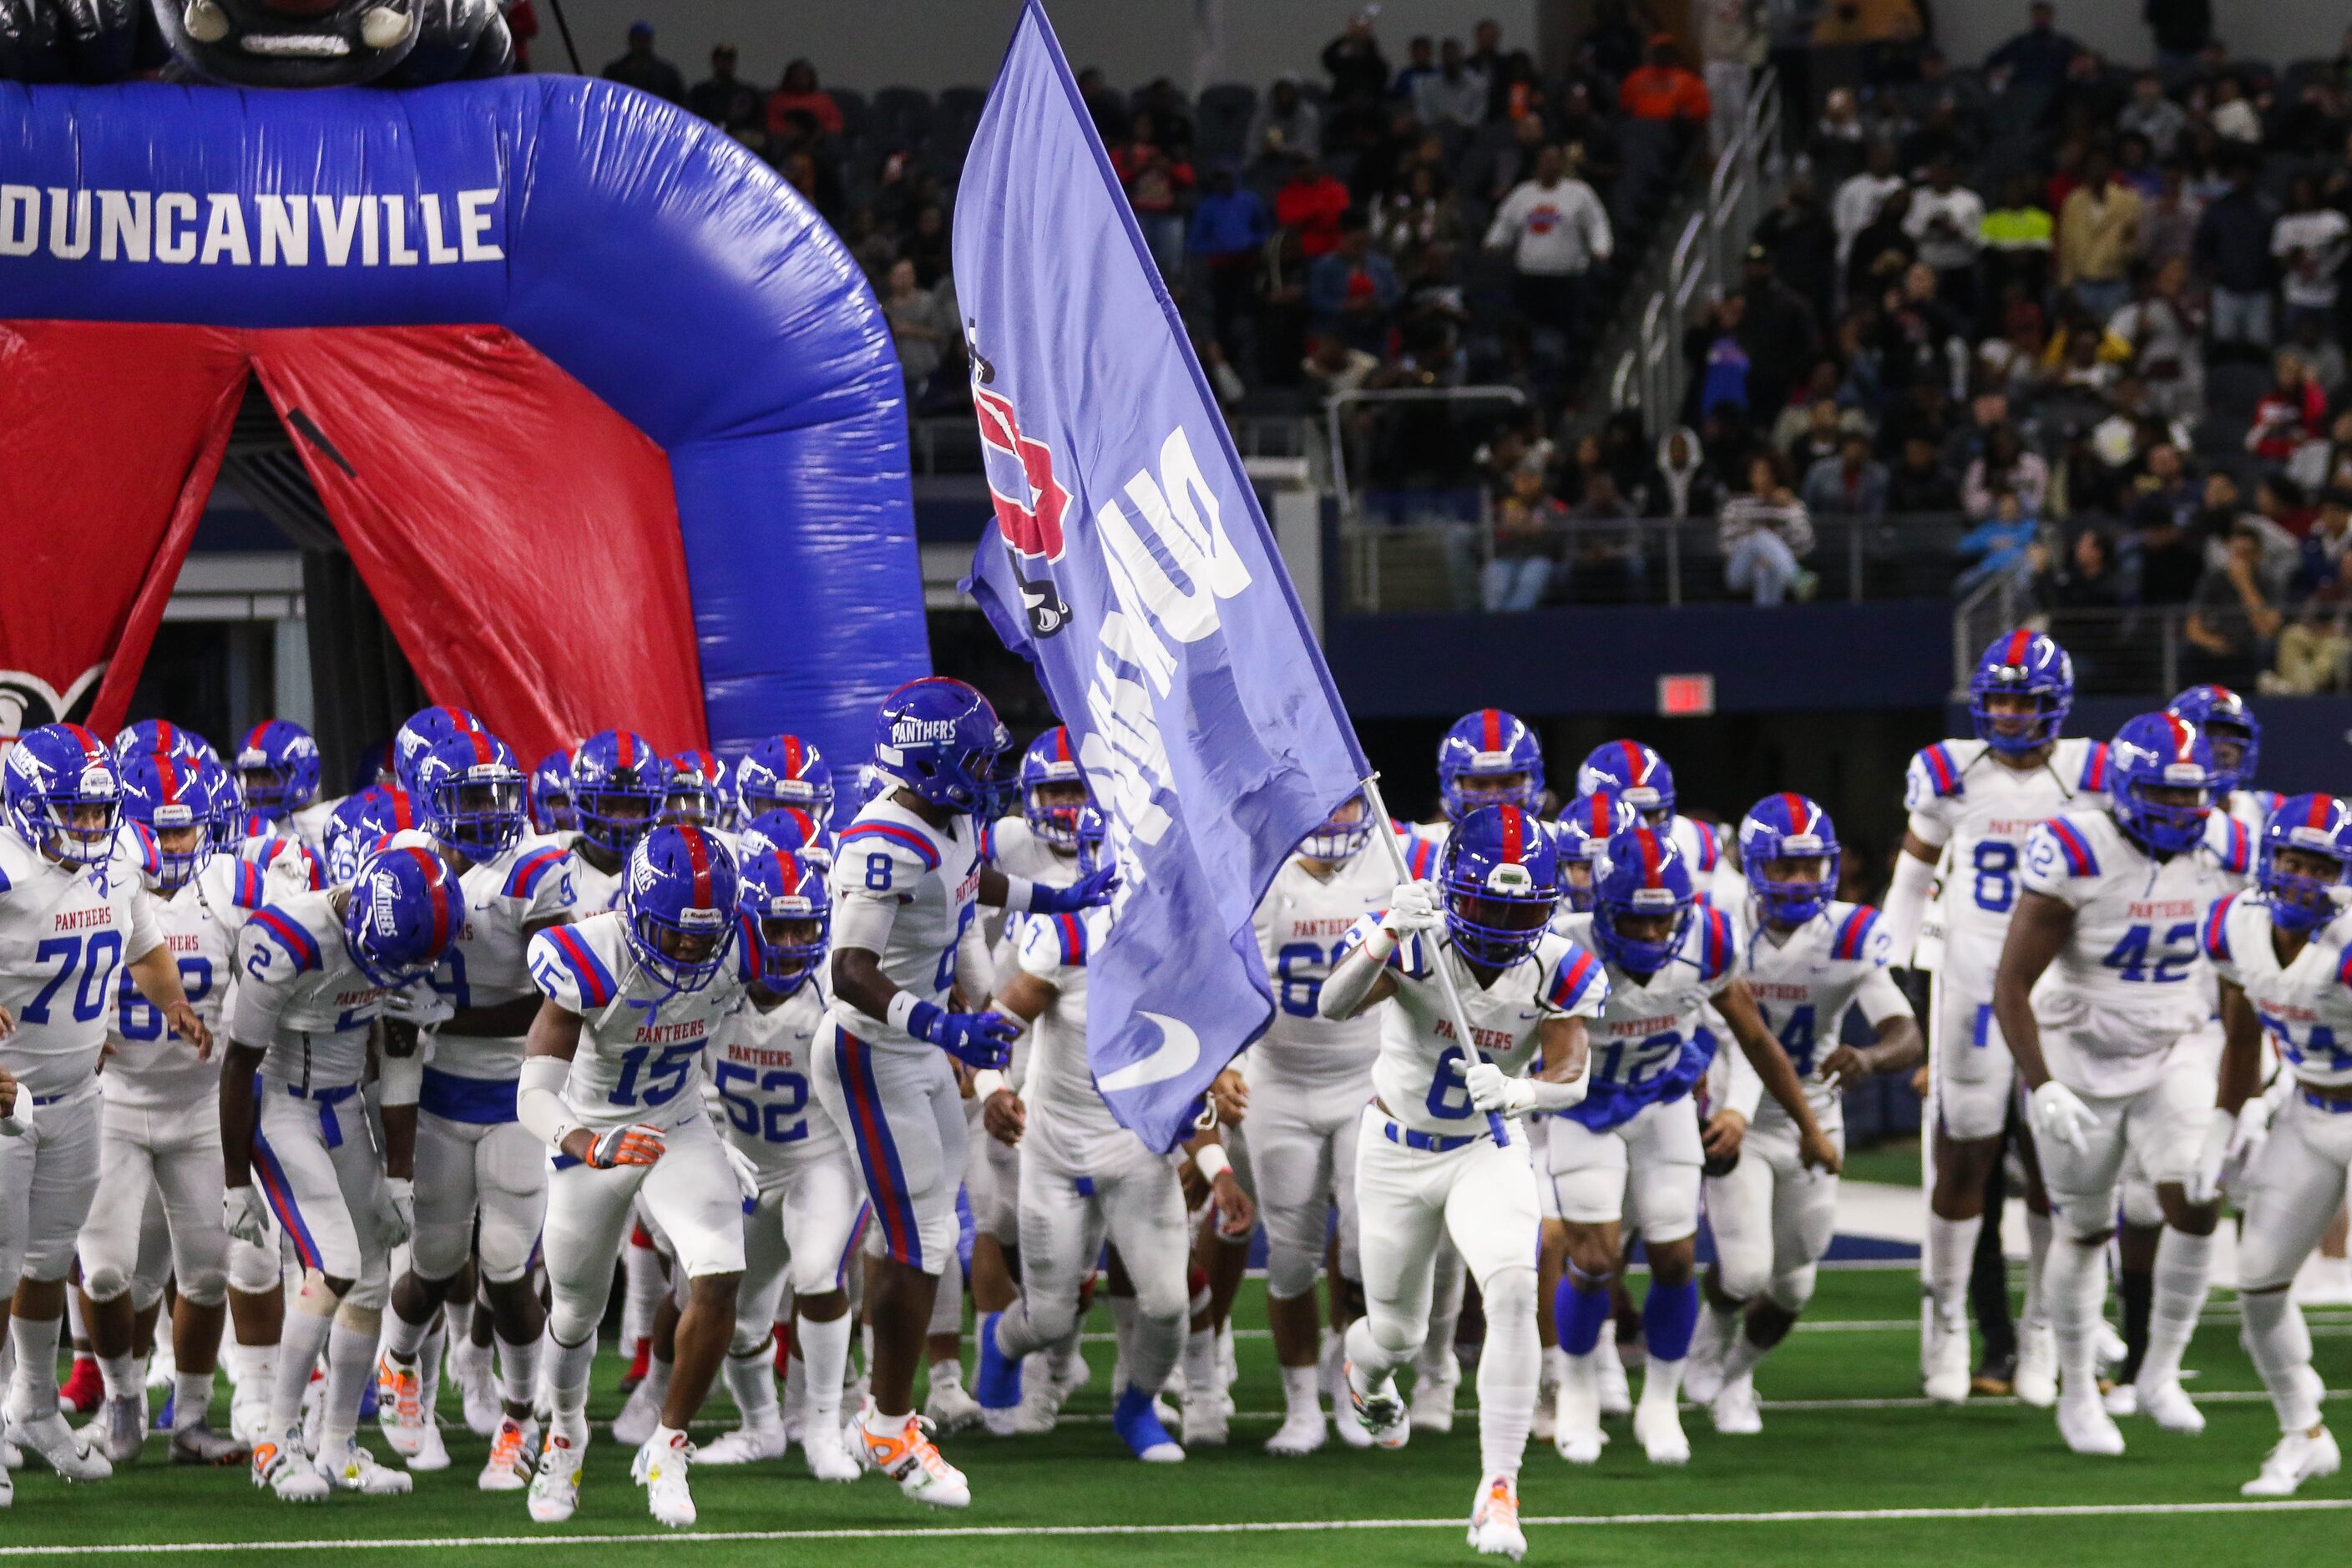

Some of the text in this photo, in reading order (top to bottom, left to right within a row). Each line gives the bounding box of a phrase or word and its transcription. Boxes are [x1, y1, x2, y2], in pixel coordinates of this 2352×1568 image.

[0, 183, 505, 267] DUNCANVILLE
[893, 720, 956, 743] PANTHERS
[865, 852, 893, 891] 8
[54, 906, 112, 932] PANTHERS
[247, 943, 272, 982] 2
[2101, 922, 2201, 982] 42
[20, 928, 123, 1025] 70
[635, 1018, 705, 1043] PANTHERS
[1433, 1019, 1513, 1051] PAHERS
[608, 1037, 710, 1107] 15
[728, 1043, 793, 1068] PANTHERS
[1601, 1031, 1683, 1085] 12
[715, 1058, 809, 1144] 52
